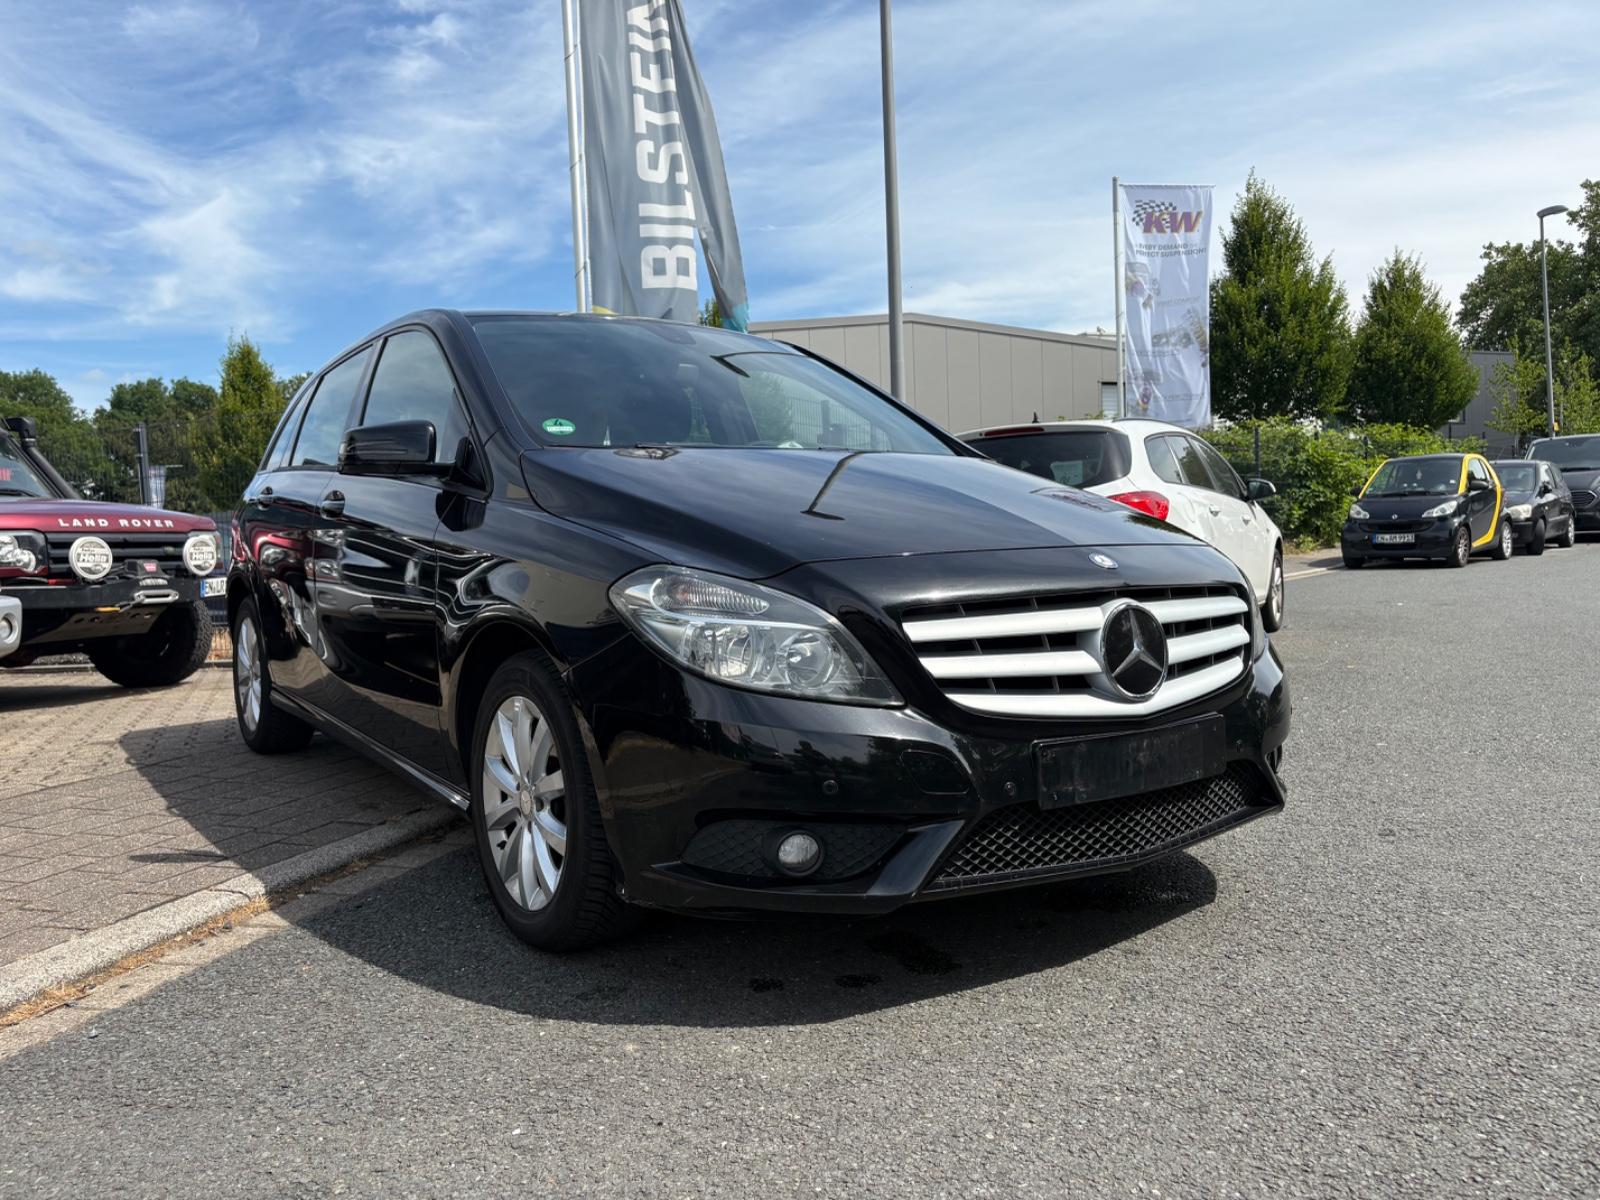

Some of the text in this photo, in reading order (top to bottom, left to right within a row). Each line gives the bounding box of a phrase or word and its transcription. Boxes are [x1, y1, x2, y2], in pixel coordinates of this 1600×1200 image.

[1142, 210, 1203, 234] KW
[58, 518, 174, 528] LAND ROVER
